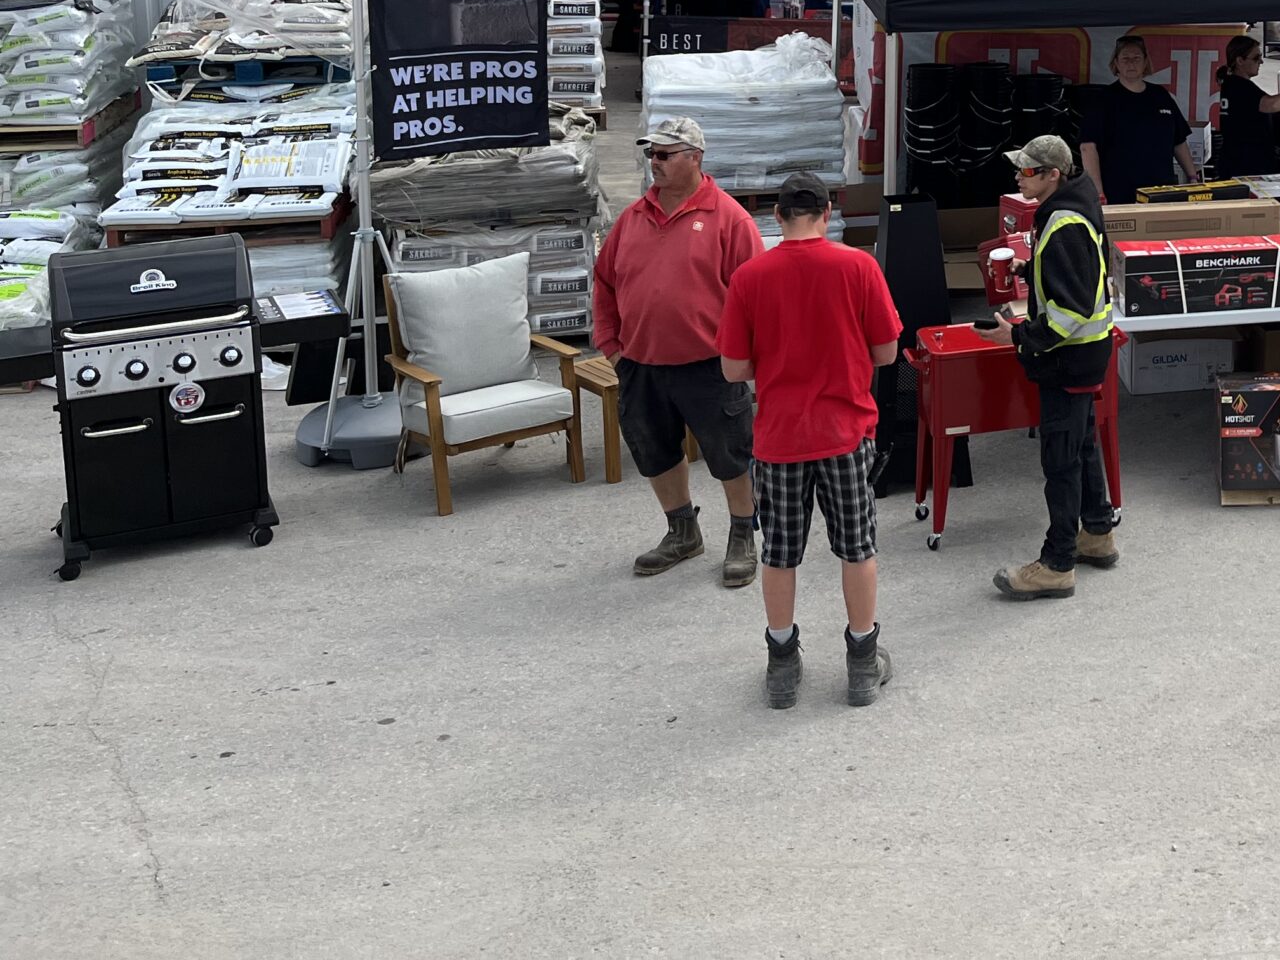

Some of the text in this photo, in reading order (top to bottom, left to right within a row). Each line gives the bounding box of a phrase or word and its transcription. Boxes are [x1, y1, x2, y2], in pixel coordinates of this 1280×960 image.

[560, 5, 589, 14] SAKRETE
[660, 33, 703, 51] BEST
[559, 45, 588, 54] SAKRETE
[390, 60, 538, 87] WE'RE PROS
[559, 82, 589, 91] SAKRETE
[392, 86, 533, 114] AT HELPING
[393, 115, 464, 141] PROS.
[1196, 256, 1261, 268] BENCHMARK
[548, 283, 580, 291] SAKRETE
[547, 318, 580, 328] SAKRETE
[1152, 354, 1187, 365] GILDAN
[1225, 415, 1256, 423] HOTSHOT
